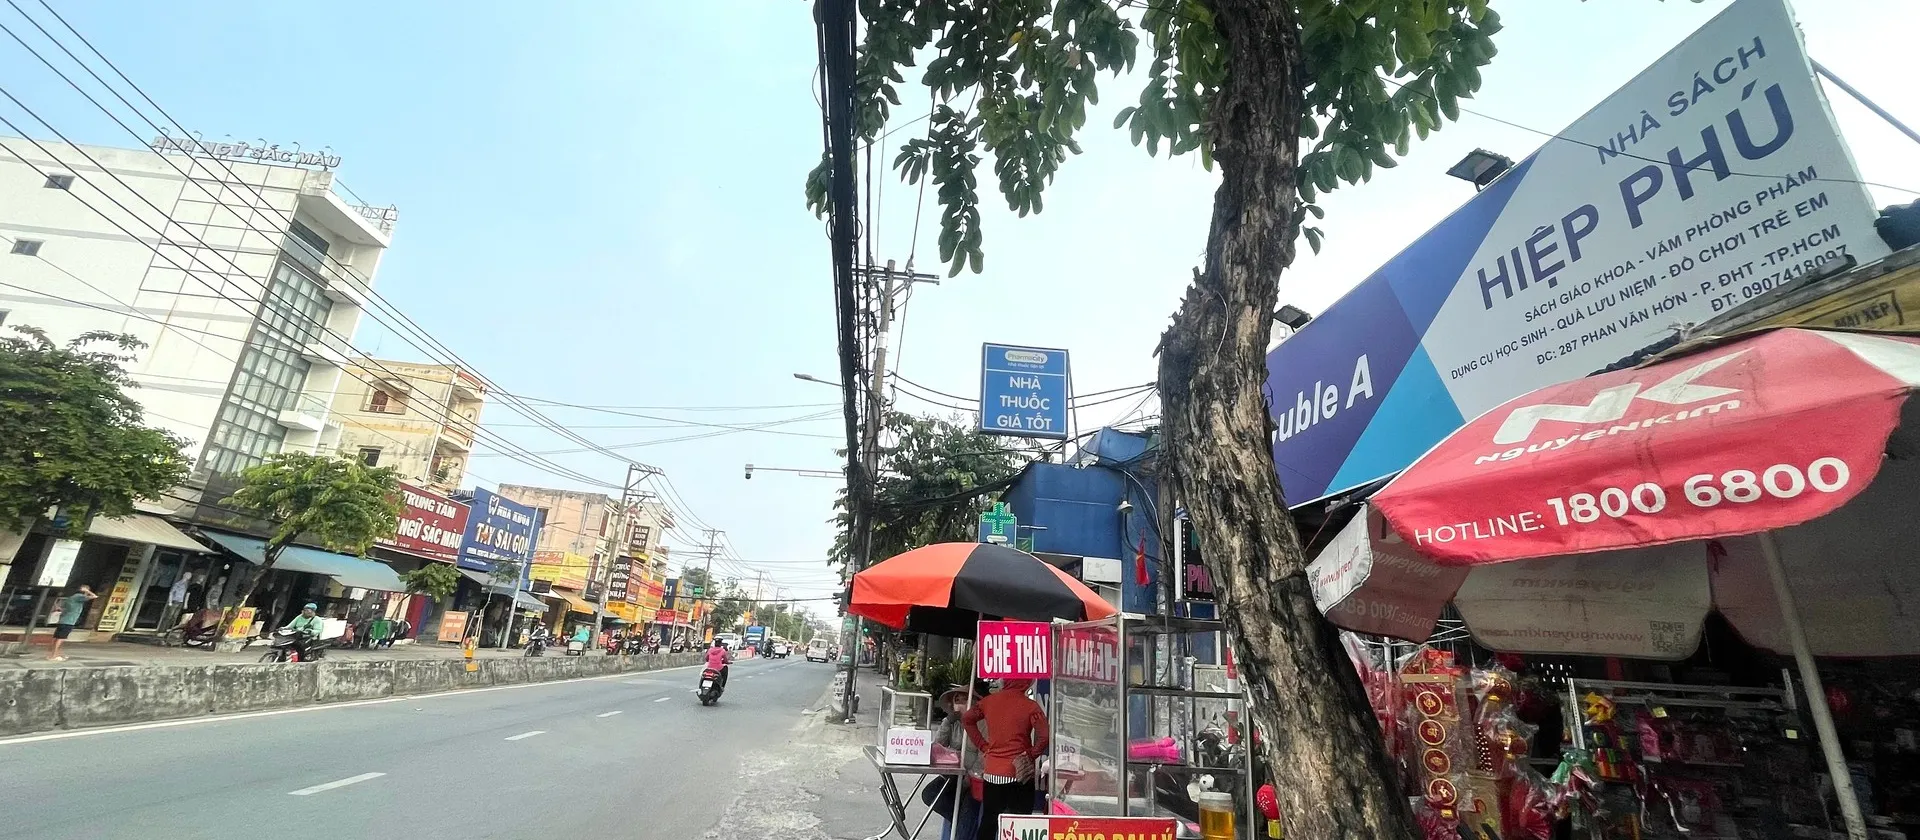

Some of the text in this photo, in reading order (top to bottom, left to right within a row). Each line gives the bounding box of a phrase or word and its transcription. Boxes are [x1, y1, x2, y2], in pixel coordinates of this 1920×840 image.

[1597, 36, 1766, 165] NHÀ SÁCH
[149, 136, 195, 152] ANH
[250, 144, 293, 163] SẮC
[296, 151, 341, 168] MÀU
[1477, 79, 1794, 310] HIỆP PHÚ
[1524, 299, 1557, 323] SÁCH
[1559, 283, 1591, 305] GIÁO
[1594, 260, 1636, 289] KHOA
[1685, 200, 1752, 242] PHÒNG
[1450, 360, 1478, 380] DỤNG
[1479, 351, 1494, 366] CỤ
[1496, 341, 1519, 360] HỌC
[1520, 326, 1548, 347] SINH
[1556, 308, 1585, 330] QUÀ
[1586, 293, 1616, 316] LƯU
[1619, 274, 1657, 303] NIỆM
[1668, 256, 1694, 278] ĐỒ
[1699, 231, 1746, 263] CHƠI
[1748, 209, 1791, 239] TRẺ
[1795, 192, 1829, 218] EM
[1710, 293, 1738, 312] ĐT:
[1536, 350, 1557, 365] ĐC:
[1558, 339, 1578, 356] 287
[1581, 322, 1617, 346] PHAN
[1619, 308, 1649, 330] VĂN
[1652, 291, 1688, 317] HỚN
[1700, 281, 1715, 296] P.
[1718, 261, 1754, 287] ĐHT
[999, 392, 1050, 411] THUỐC
[1009, 375, 1042, 390] NHÀ
[1272, 353, 1374, 445] uble A
[1492, 347, 1756, 445] NK
[996, 412, 1052, 431] GIÁ TỐT
[404, 490, 457, 519] TRUNG TÂM
[1413, 456, 1850, 547] HOTLINE: 1800 6800
[398, 517, 424, 540] NGỮ
[421, 519, 441, 545] SẮC
[440, 528, 462, 550] MÀU
[495, 523, 512, 551] SÀI
[608, 590, 626, 599] NHẬT
[983, 626, 1048, 674] CHÈ THÁI
